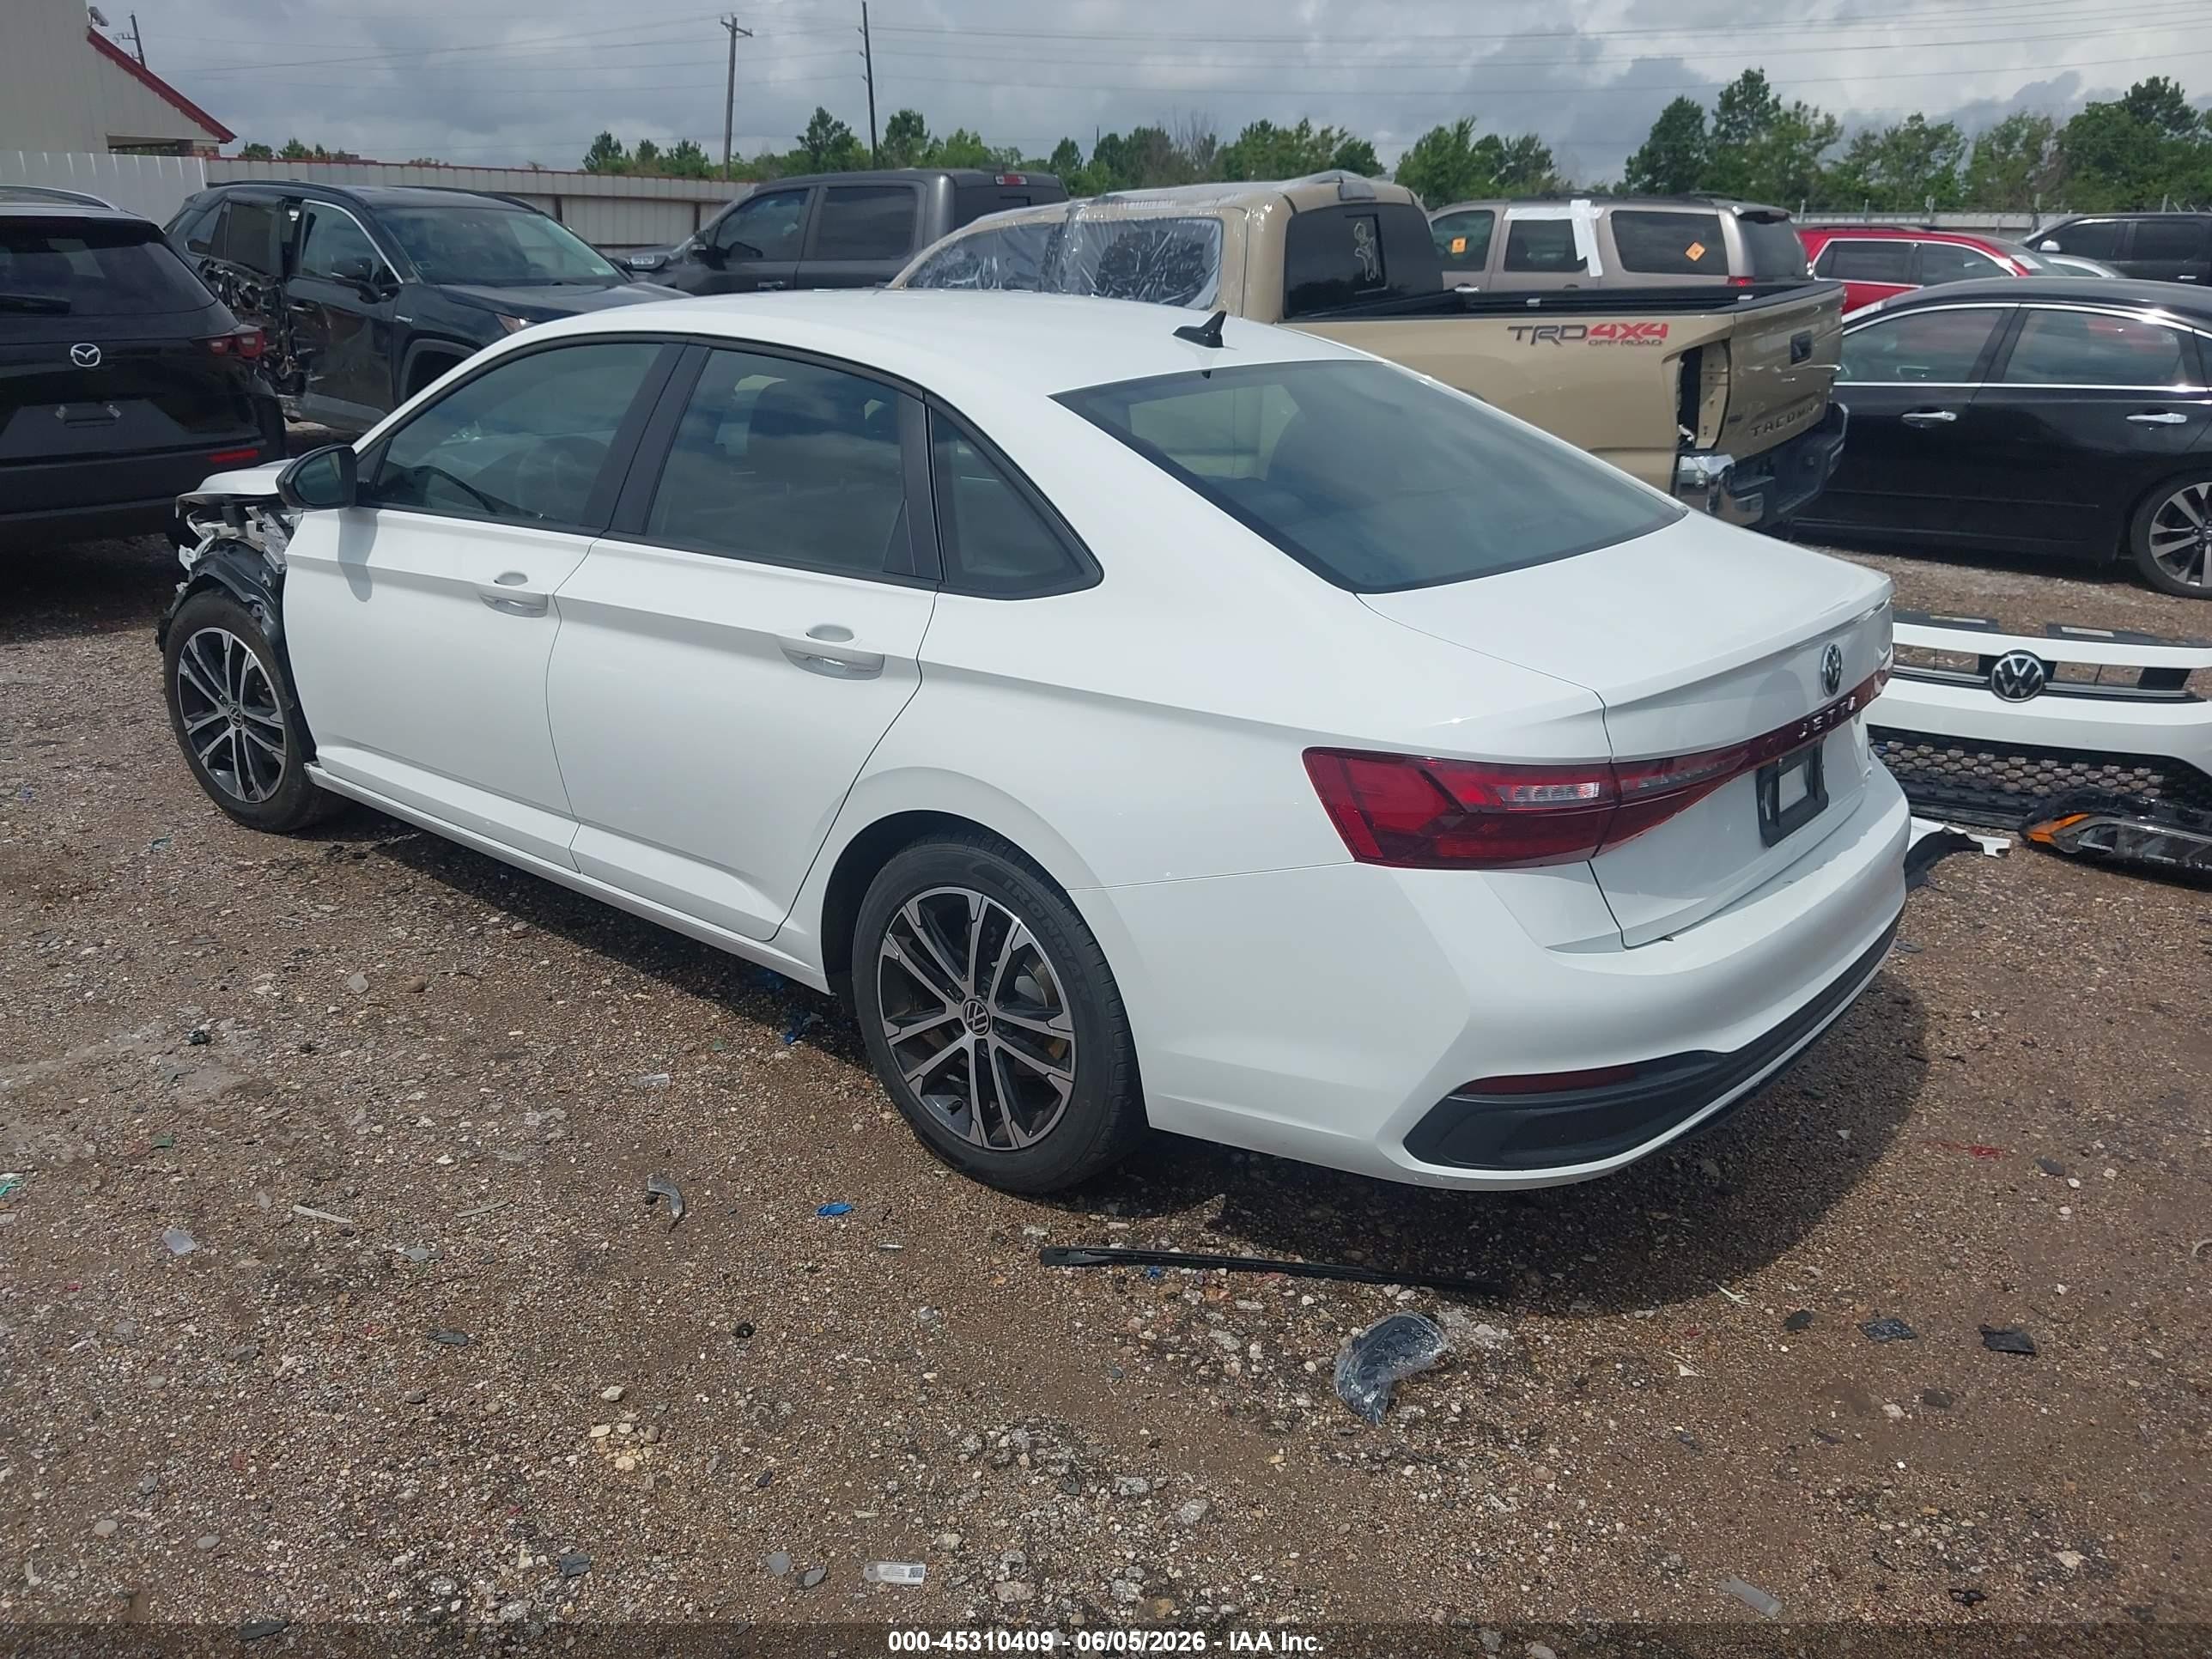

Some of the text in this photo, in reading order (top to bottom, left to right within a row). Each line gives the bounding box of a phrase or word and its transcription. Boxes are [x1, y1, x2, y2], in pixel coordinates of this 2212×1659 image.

[1507, 322, 1668, 346] TRD 4X4
[1750, 404, 1816, 436] TACOMA
[1798, 696, 1856, 738] JETTA
